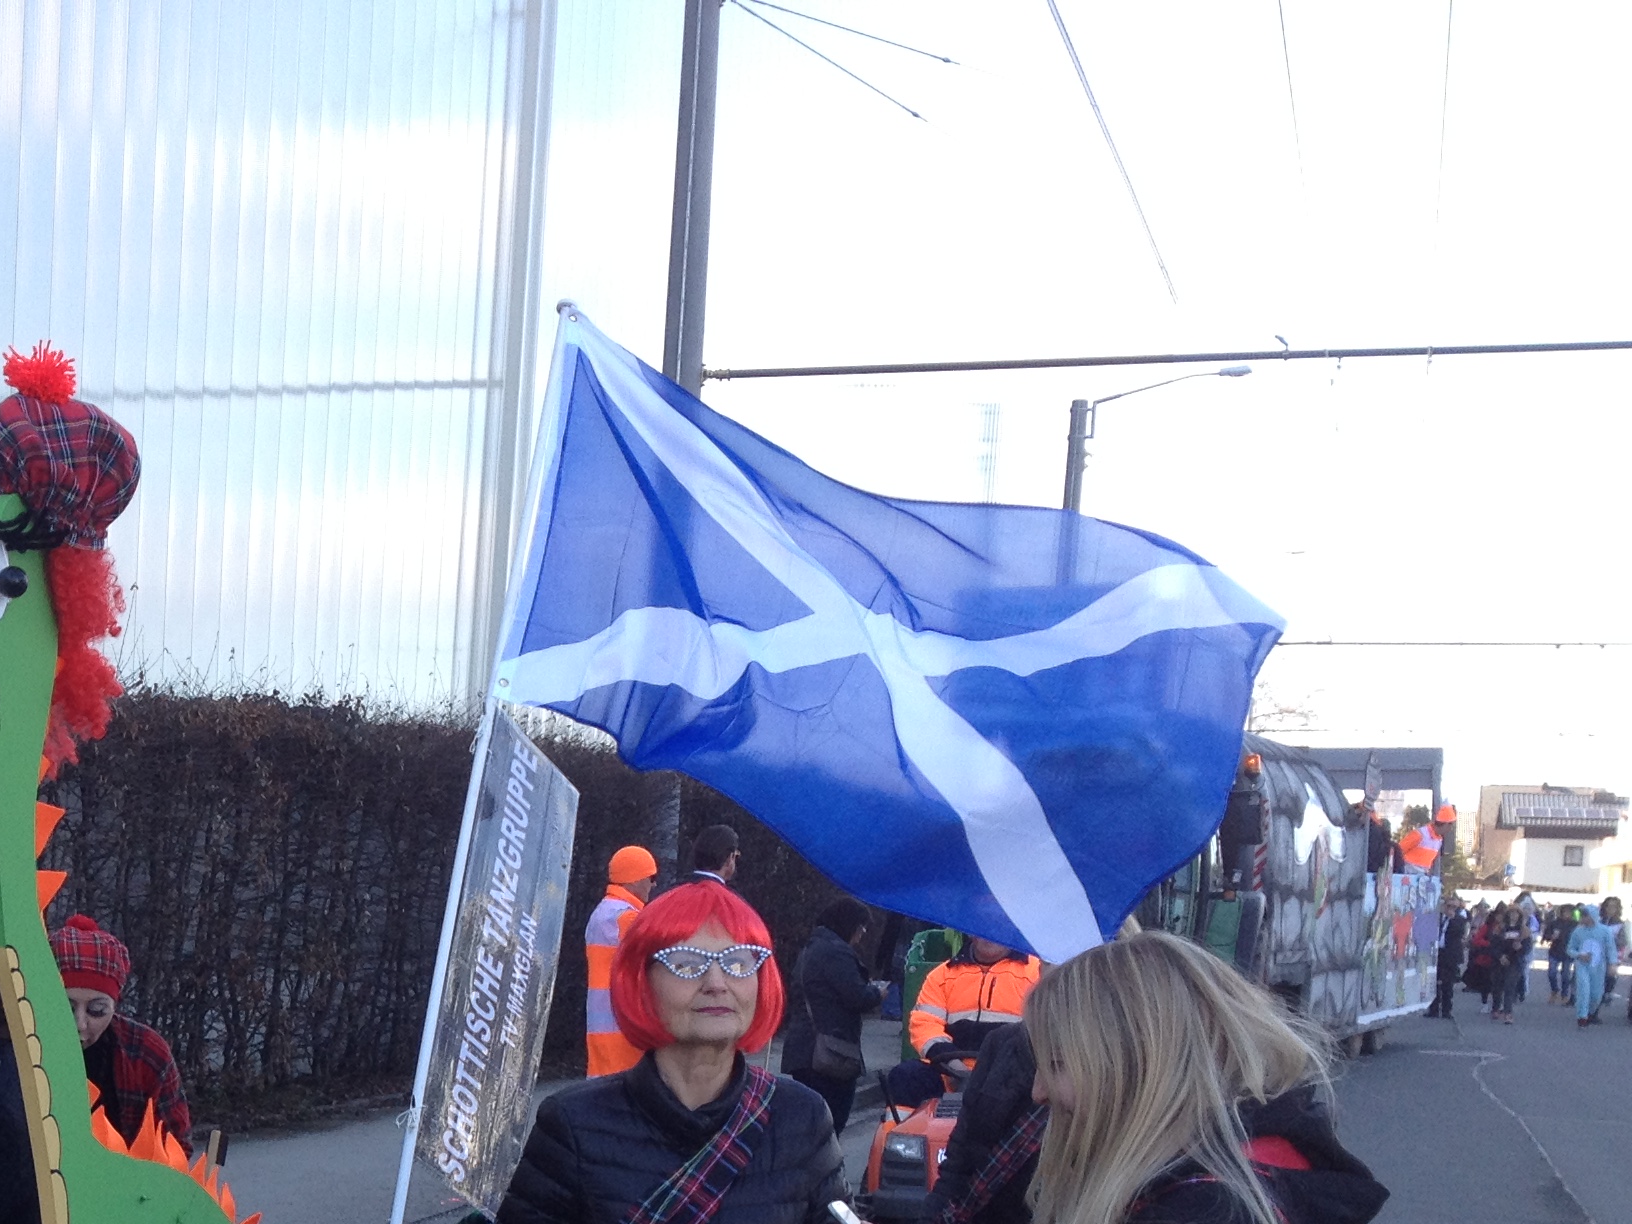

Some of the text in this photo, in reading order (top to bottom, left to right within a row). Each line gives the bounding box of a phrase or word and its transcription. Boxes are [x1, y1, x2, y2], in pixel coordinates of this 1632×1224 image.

[438, 739, 538, 1183] SCHOTTISCHE TANZGRUPPE
[500, 911, 538, 1049] TV MAXGLAN
